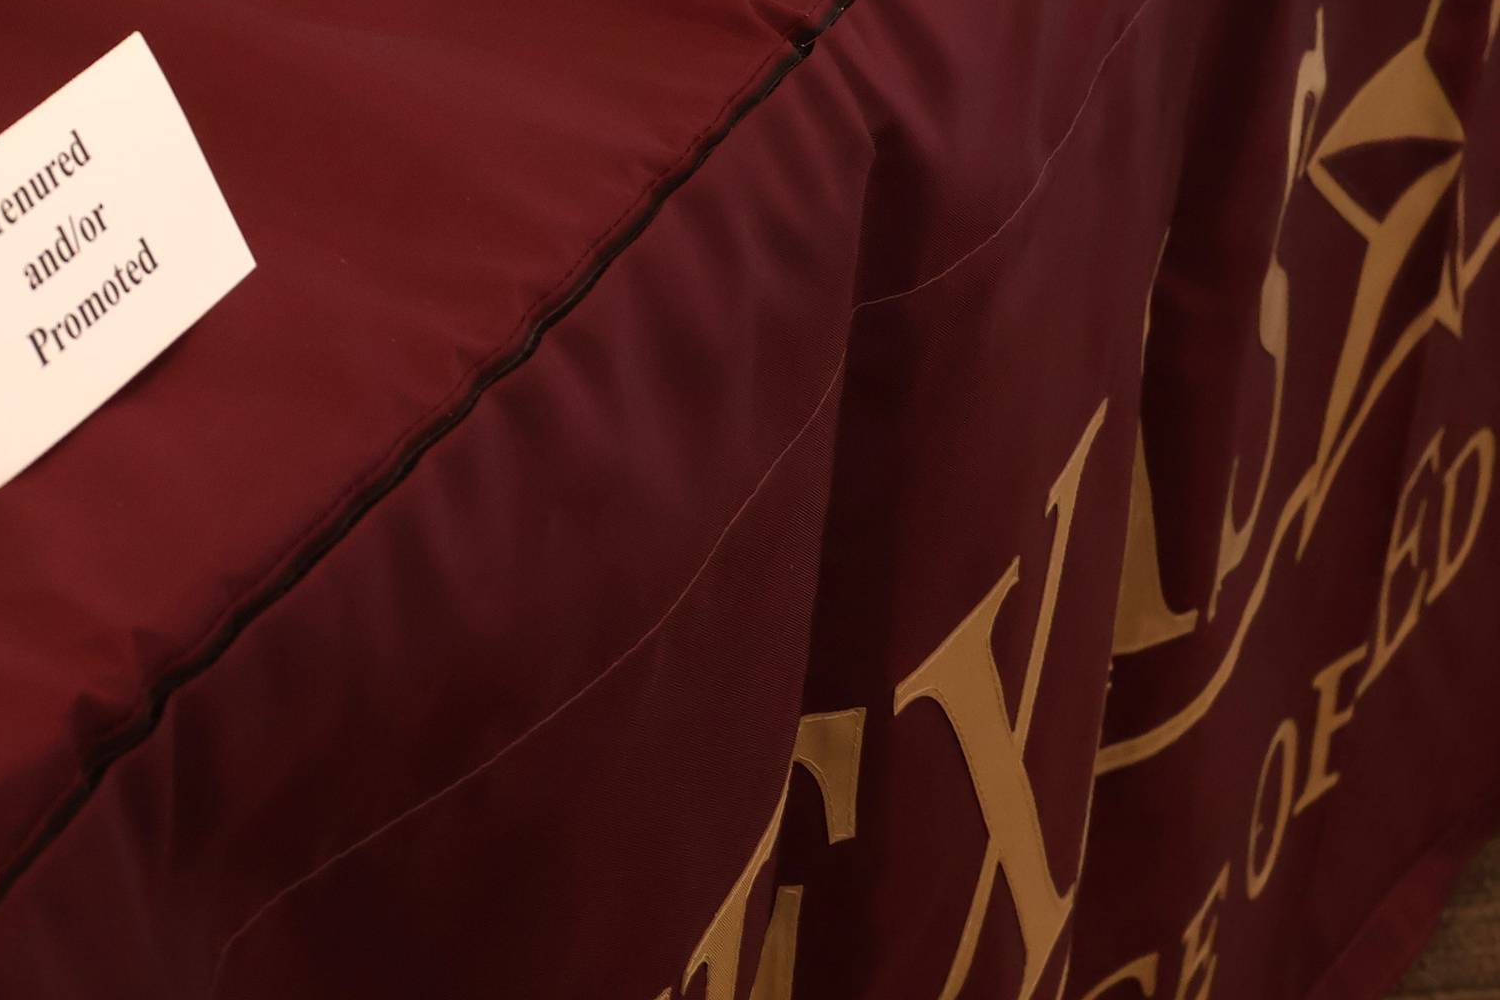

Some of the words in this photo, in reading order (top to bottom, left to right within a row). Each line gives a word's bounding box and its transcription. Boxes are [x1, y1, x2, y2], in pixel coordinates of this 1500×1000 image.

[22, 202, 109, 291] and/or
[25, 236, 160, 368] Promoted
[1245, 640, 1369, 902] OF
